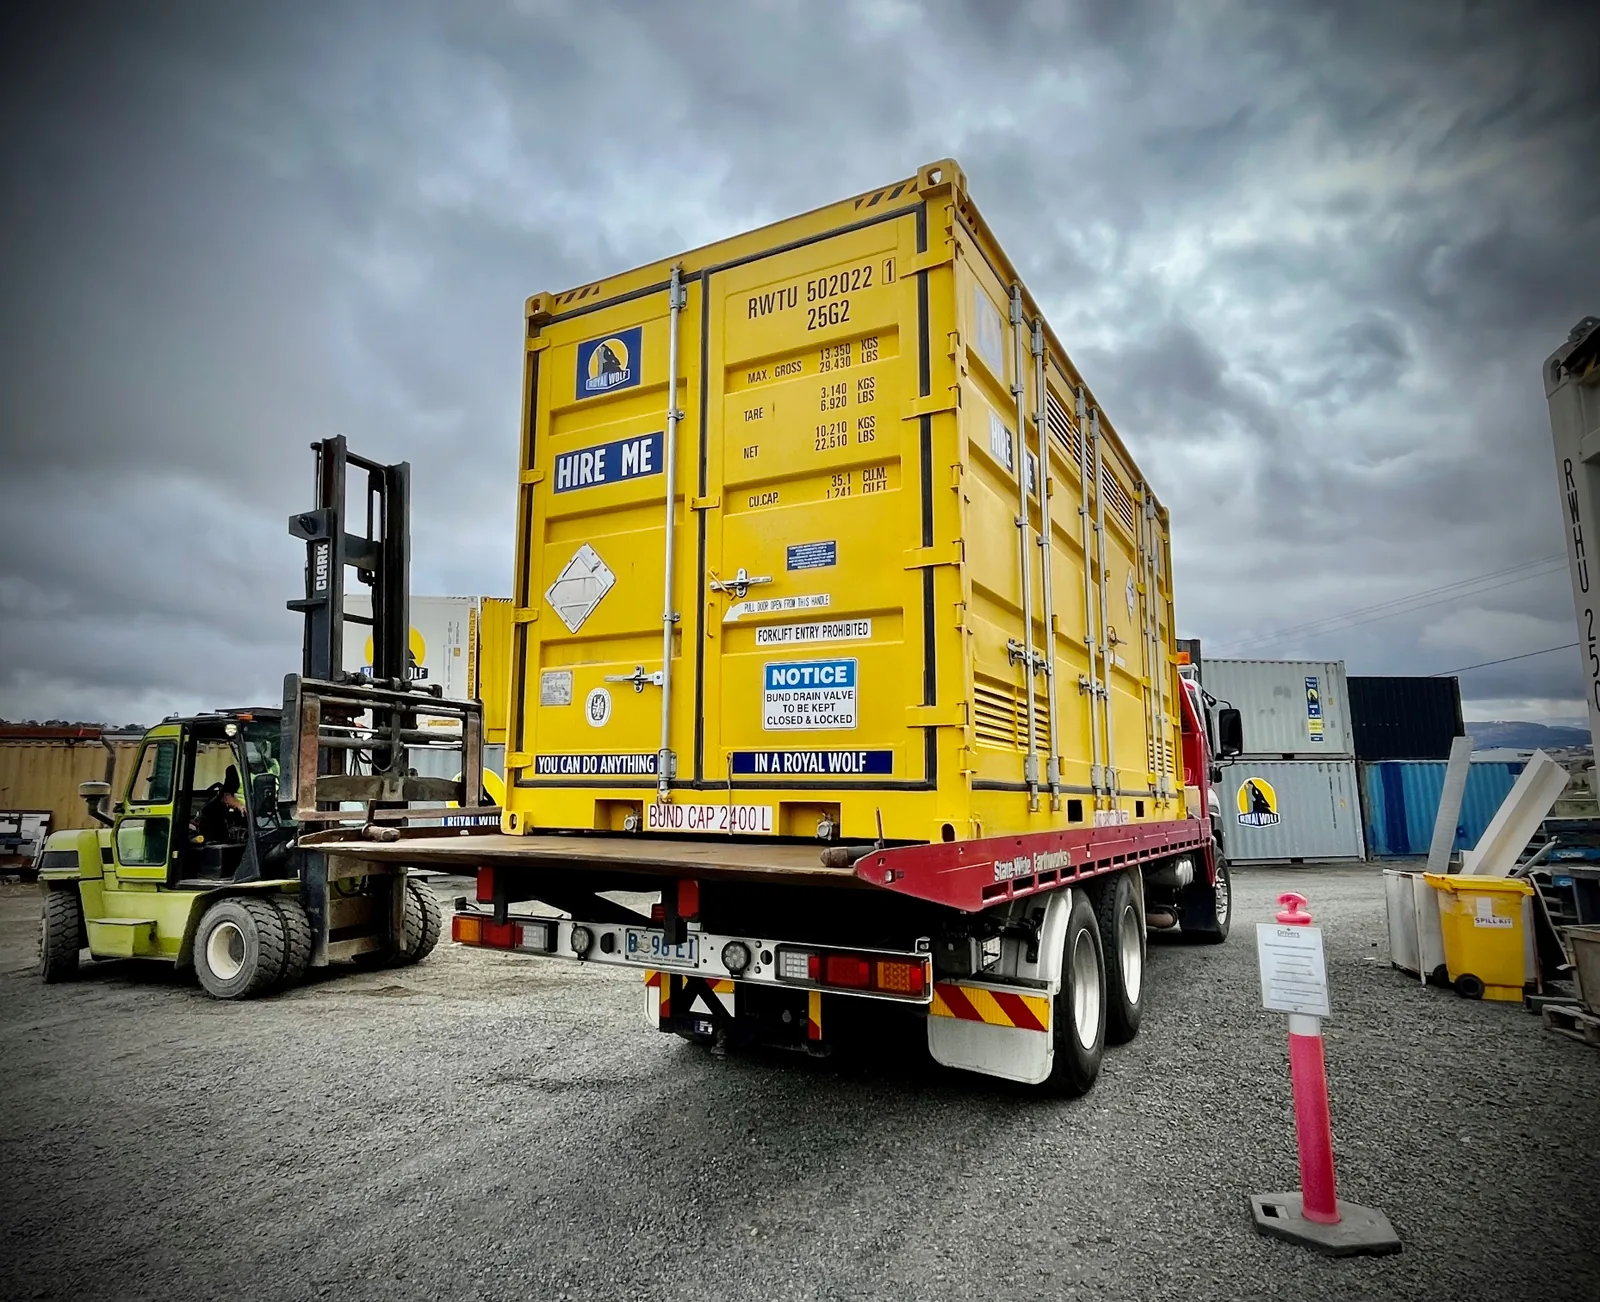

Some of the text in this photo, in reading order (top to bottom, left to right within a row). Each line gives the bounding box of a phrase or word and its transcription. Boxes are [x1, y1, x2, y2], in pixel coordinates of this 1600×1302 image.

[748, 259, 894, 320] RWTU 502022 1
[807, 300, 850, 331] 25G2
[819, 336, 878, 361] 13.350 KGS
[774, 360, 802, 377] GROSS
[819, 355, 851, 373] 29.430
[861, 350, 878, 364] LBS
[589, 371, 626, 388] ROYAL WOLF
[820, 376, 875, 399] 3.140 KGS
[820, 389, 875, 412] 6.920 LBS
[744, 407, 764, 422] TARE
[815, 415, 876, 438] 10.210 KGS
[815, 429, 875, 451] 22.510 LBS
[743, 445, 759, 460] NET
[557, 438, 653, 490] HIRE ME
[831, 472, 851, 488] 35.1
[862, 480, 887, 494] CUFT
[1563, 458, 1589, 593] RWHU
[316, 543, 329, 591] CLARK
[744, 595, 829, 613] PULL DOOR OPEN FROM THIS HANDLE
[758, 622, 869, 643] FORKLIFT ENTRY PROHIBITED
[771, 665, 848, 686] NOTICE
[766, 690, 854, 702] BUND DRAIN VALVE
[783, 702, 836, 713] TO BE KEPT
[766, 714, 853, 726] CLOSED & LOCKED
[538, 755, 655, 774] YOU CAN DO ANYTHING
[754, 751, 867, 773] IN A ROYAL WOLF
[649, 804, 771, 831] BUND CAP 2400 L
[1239, 812, 1278, 825] ROYAL WOLF
